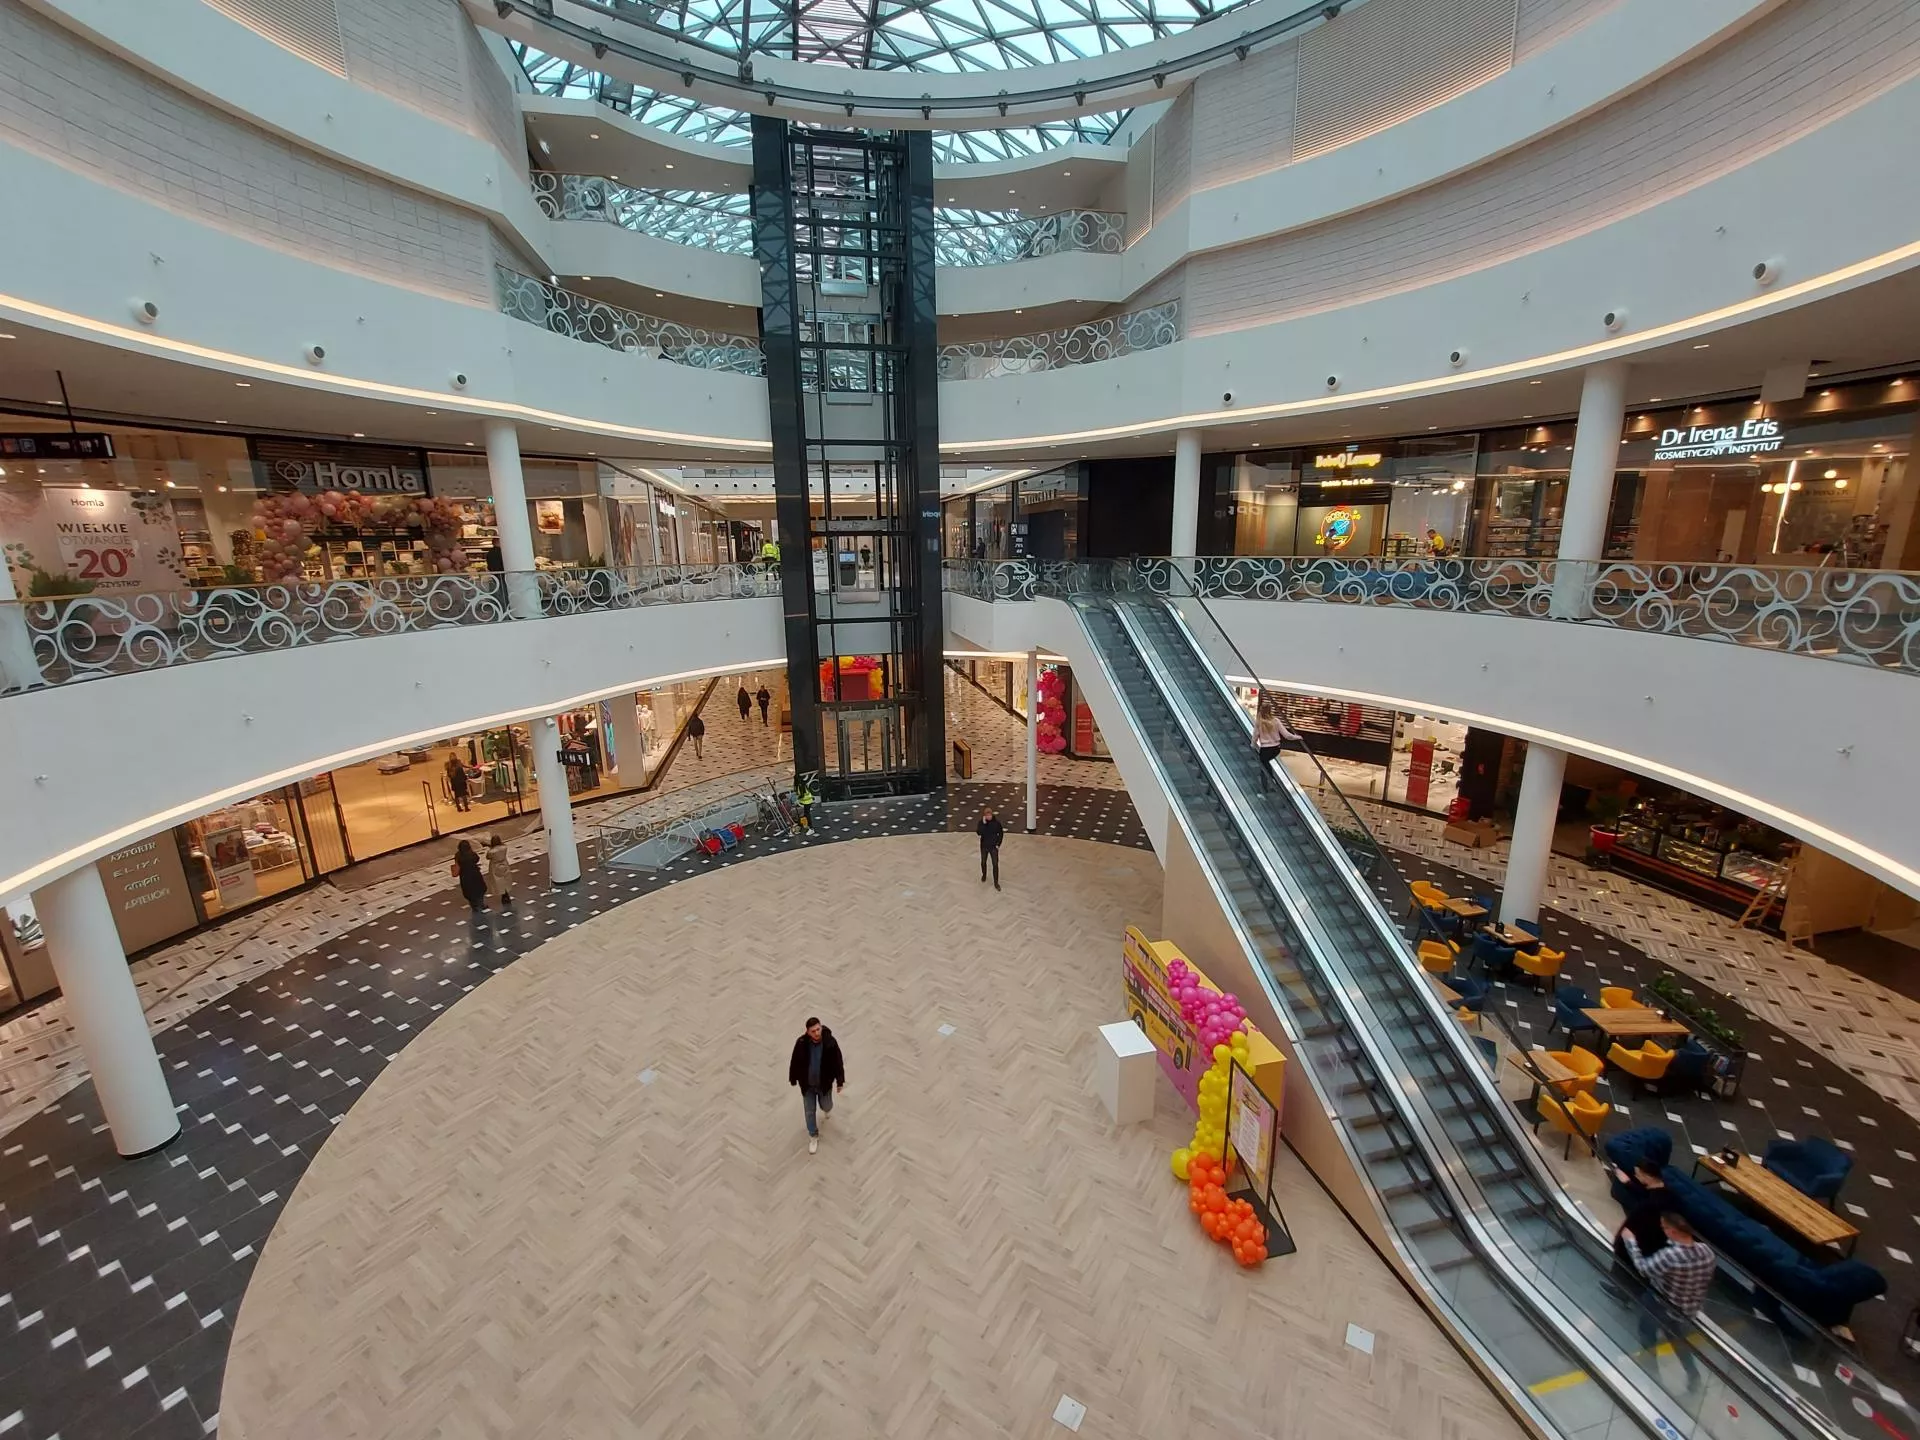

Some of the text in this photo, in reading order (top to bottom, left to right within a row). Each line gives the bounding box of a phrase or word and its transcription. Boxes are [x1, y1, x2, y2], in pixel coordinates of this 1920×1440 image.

[1661, 418, 1778, 446] Dr Irena Eris
[1655, 441, 1781, 460] KOSMETYCZNY INSTYTUT
[314, 461, 418, 491] Homla
[70, 498, 105, 507] Homla
[56, 523, 129, 533] WIELKIE
[61, 535, 132, 545] OTWARCIE
